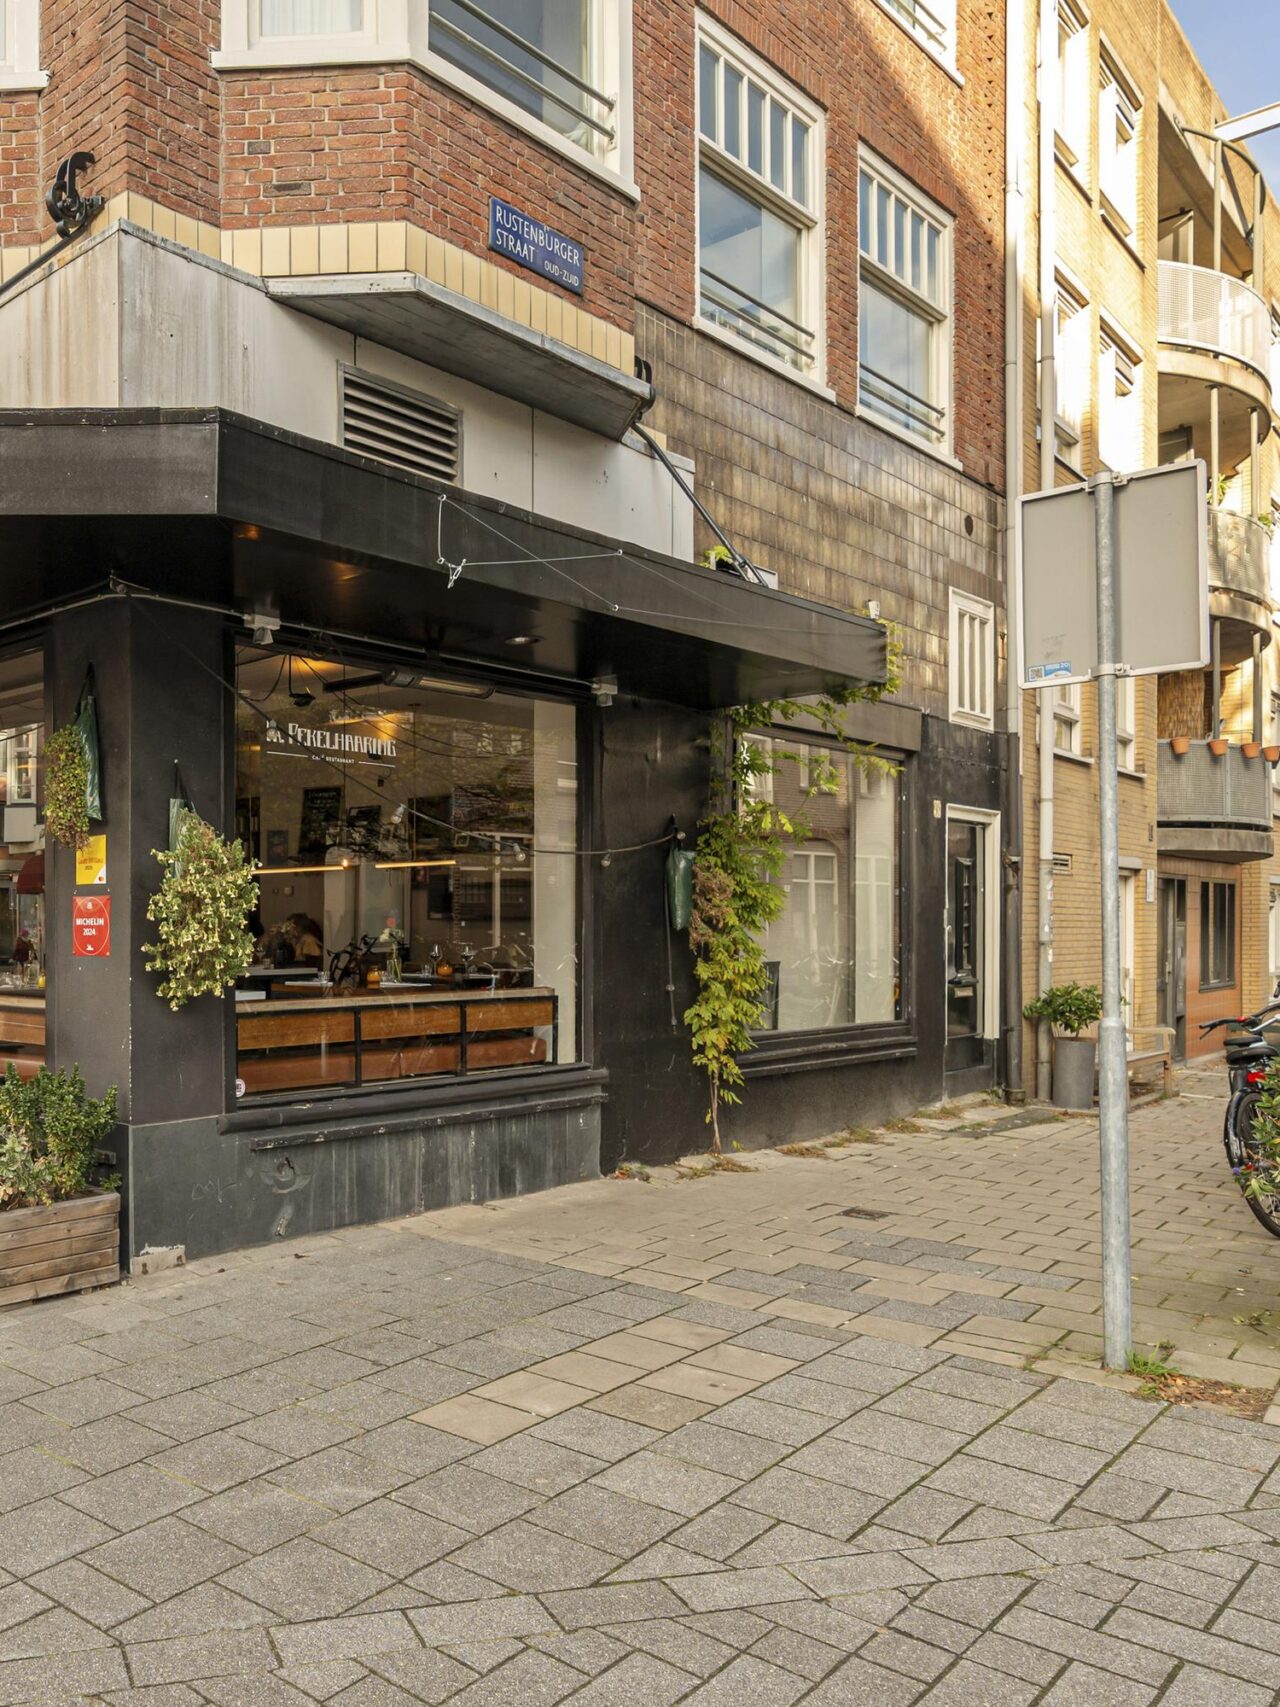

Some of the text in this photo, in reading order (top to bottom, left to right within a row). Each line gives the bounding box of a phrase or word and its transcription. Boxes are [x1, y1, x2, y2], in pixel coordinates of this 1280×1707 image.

[496, 205, 580, 267] RUSTENBURGER
[496, 228, 536, 263] STRAAT
[544, 260, 579, 287] OUD-ZUID
[75, 917, 105, 926] MICHELIN
[82, 928, 96, 936] 2024
